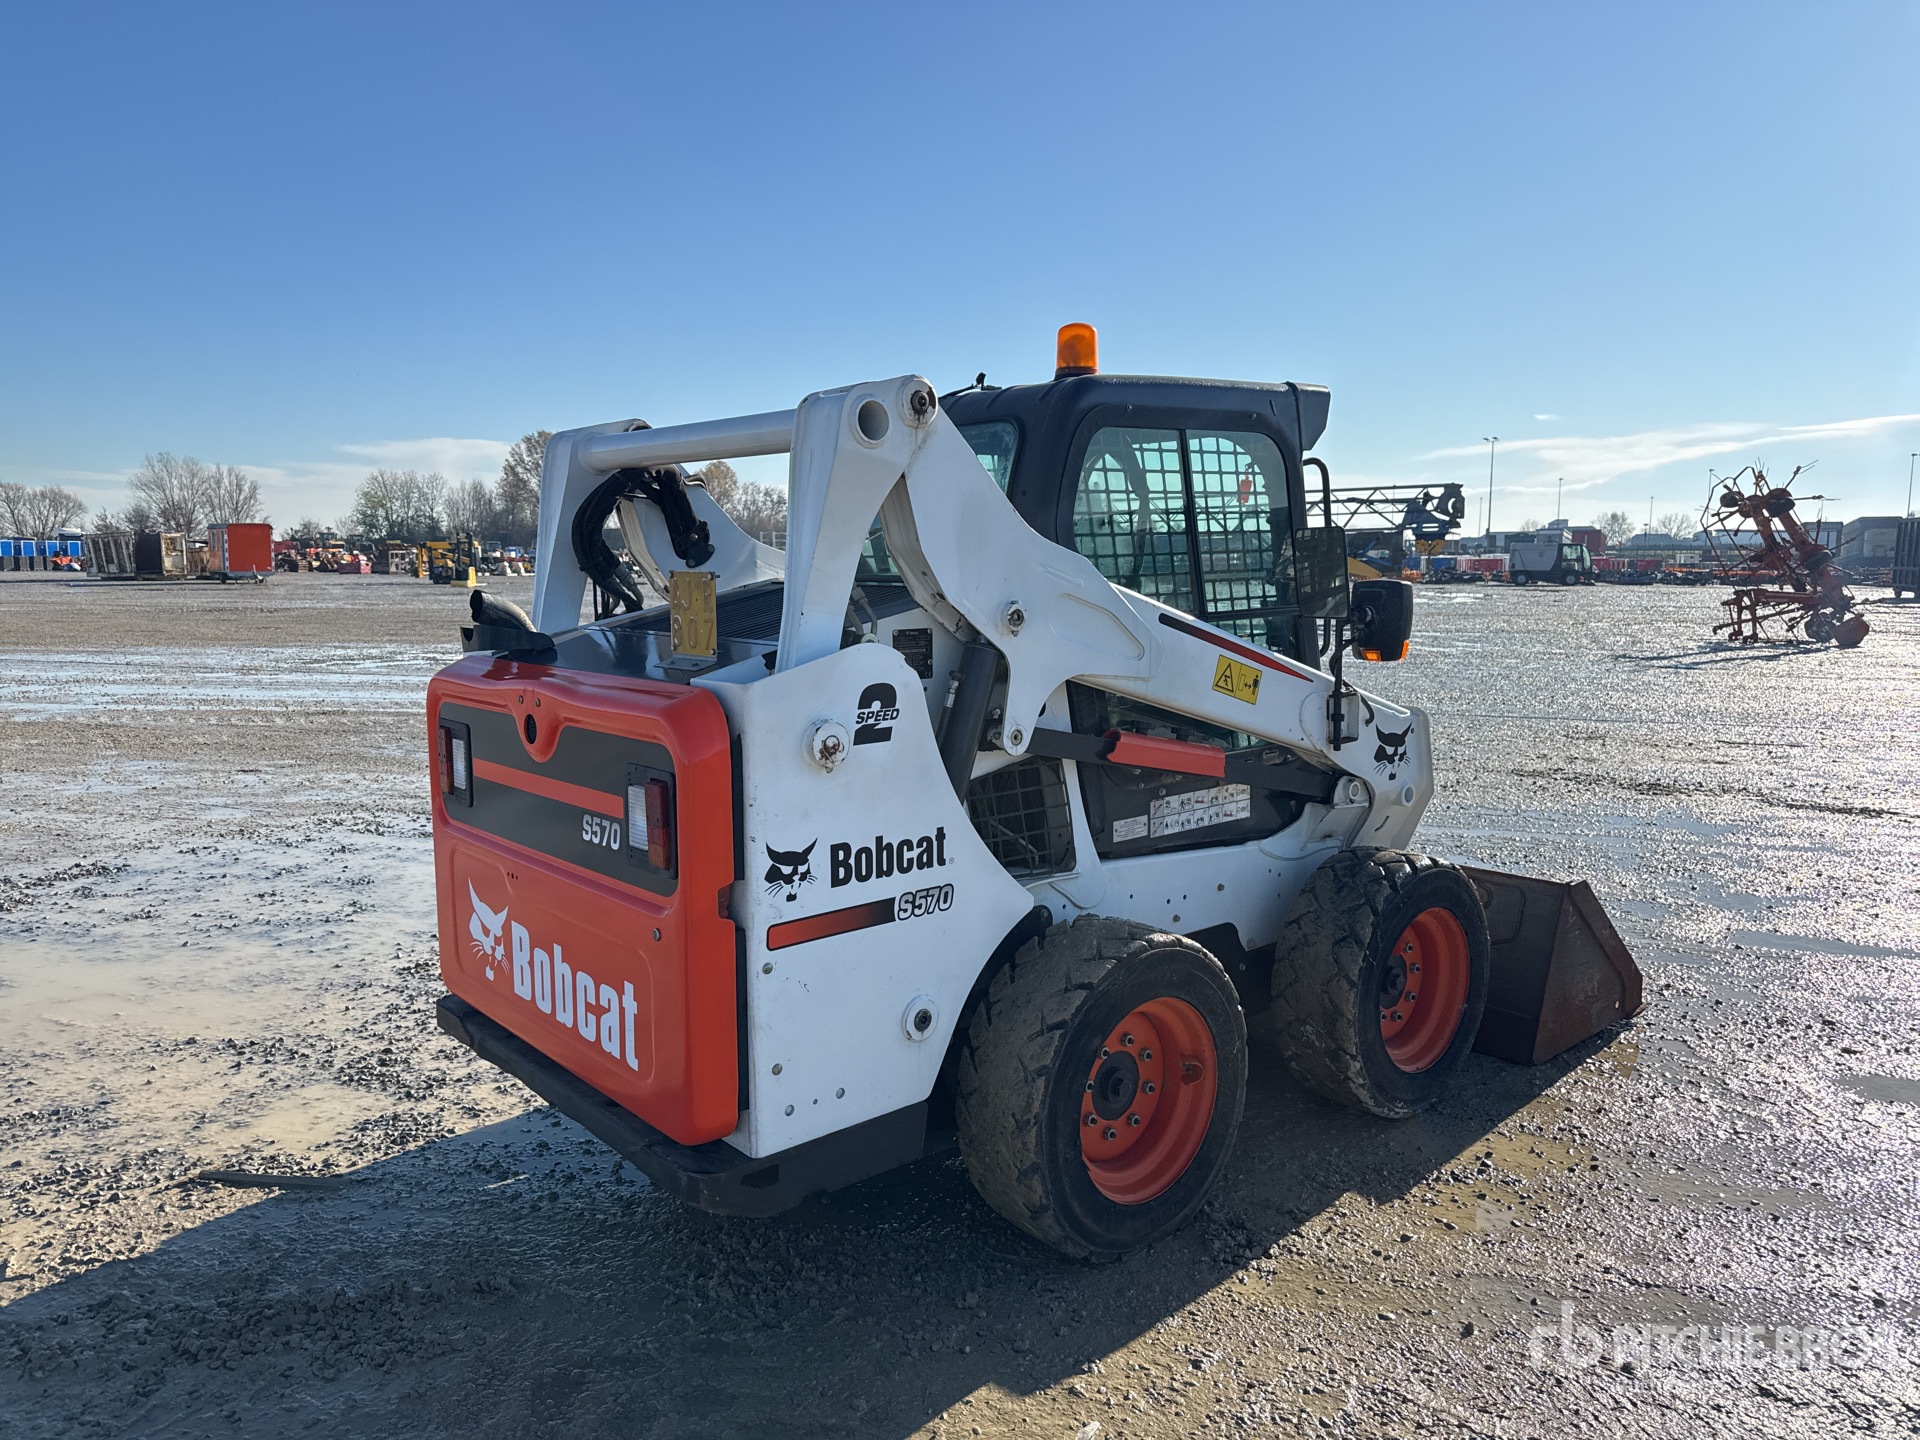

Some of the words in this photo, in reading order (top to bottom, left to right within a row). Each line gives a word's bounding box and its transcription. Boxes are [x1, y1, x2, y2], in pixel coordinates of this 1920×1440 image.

[853, 682, 897, 746] 2
[855, 706, 900, 725] SPEED
[582, 814, 621, 850] S570
[830, 827, 946, 888] Bobcat
[896, 883, 954, 921] S570
[511, 920, 639, 1072] Bobcat
